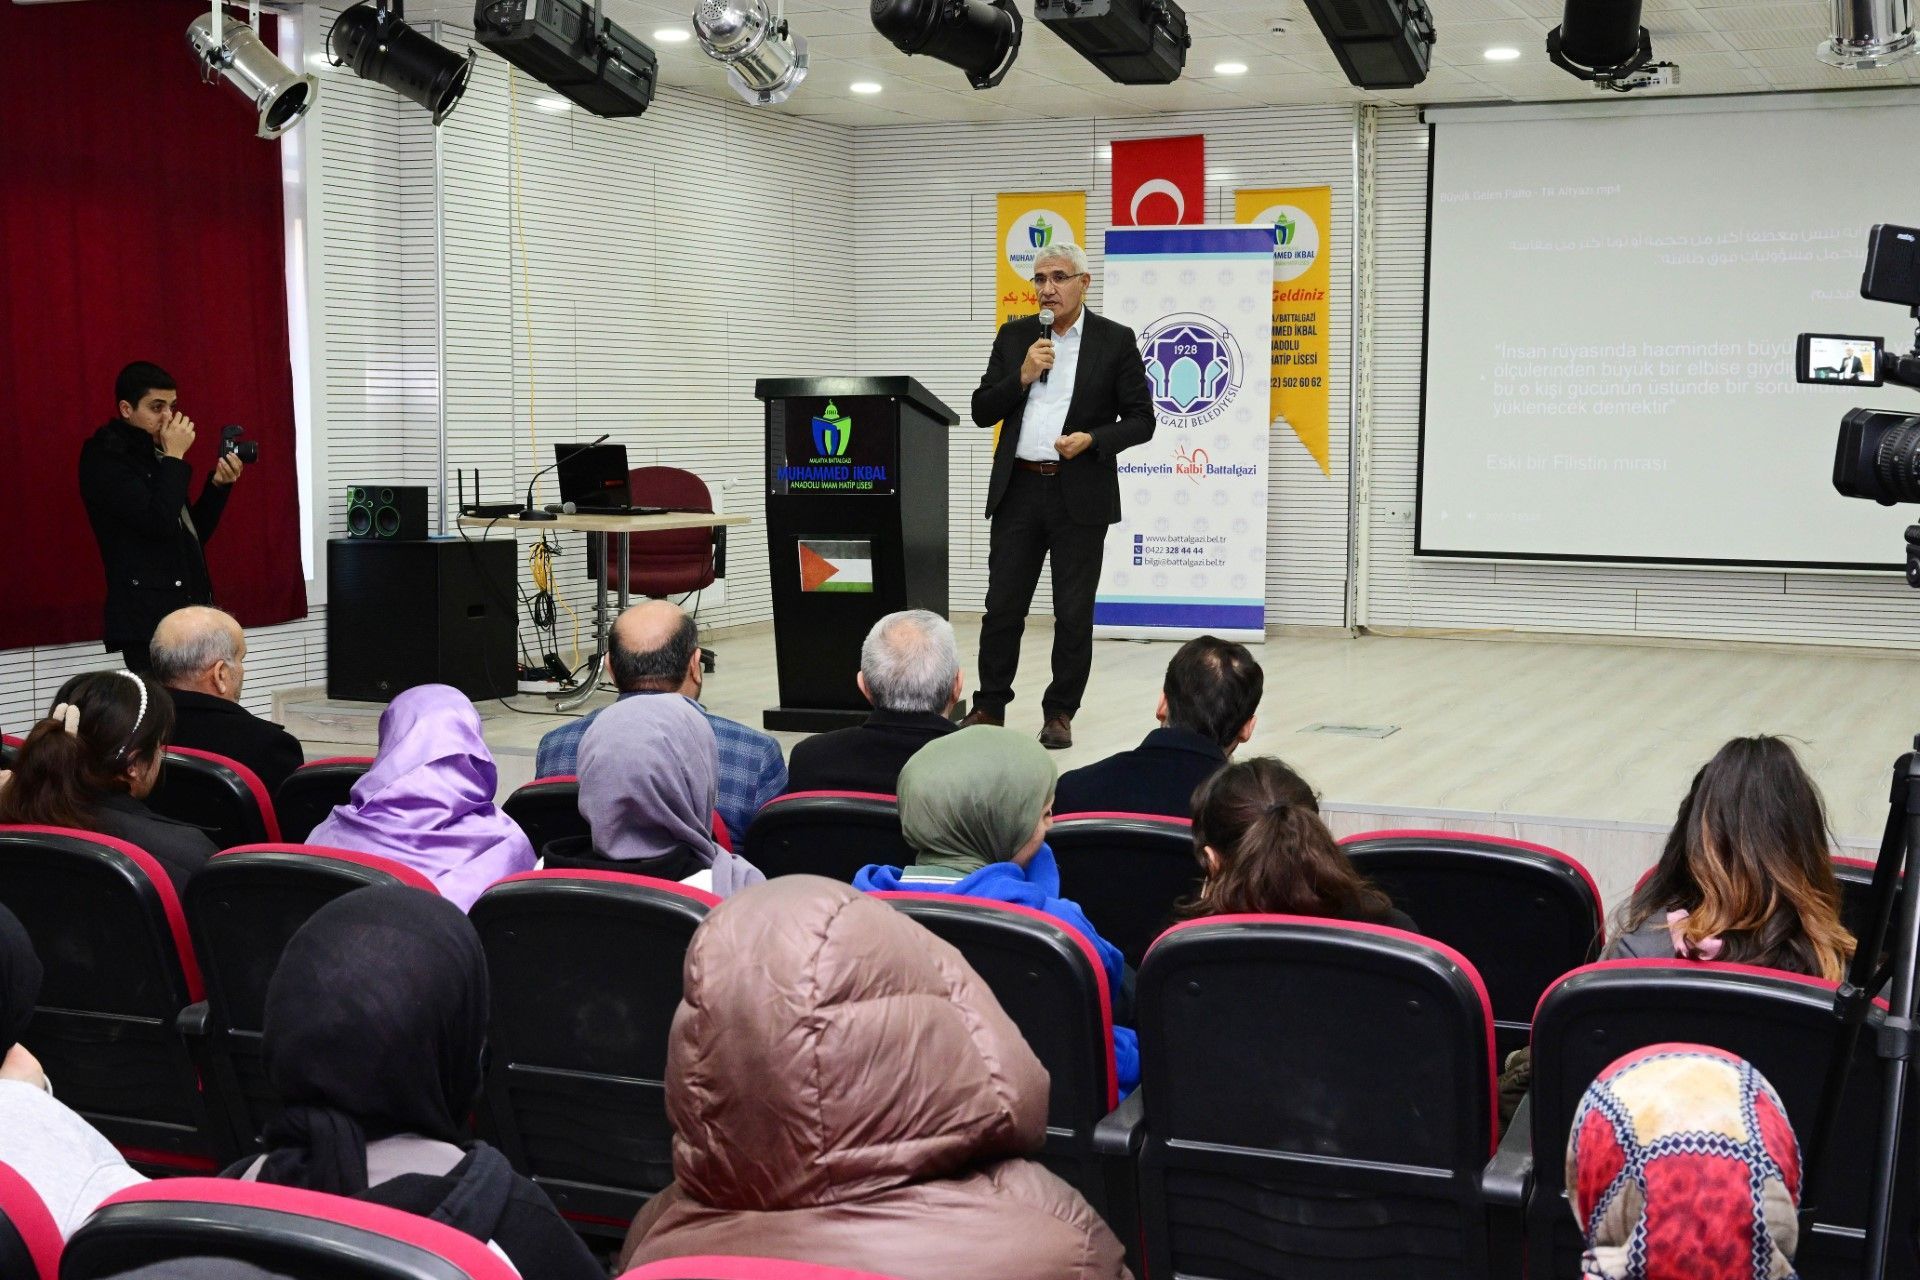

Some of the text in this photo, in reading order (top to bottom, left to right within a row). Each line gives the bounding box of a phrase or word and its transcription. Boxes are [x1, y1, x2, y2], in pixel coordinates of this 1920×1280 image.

[1294, 323, 1318, 336] İKBAL
[1174, 344, 1199, 355] 1928
[1747, 336, 1798, 360] büyü
[1293, 352, 1318, 365] LİSESİ
[1283, 376, 1298, 388] 502
[1299, 376, 1310, 388] 60
[1311, 376, 1322, 388] 62
[1494, 380, 1515, 396] bu
[1487, 453, 1522, 471] Eski
[1526, 453, 1549, 470] bir
[777, 465, 850, 481] MUHAMMED
[1176, 463, 1203, 474] Kalbi
[1206, 464, 1257, 477] Battalgazi
[790, 479, 874, 490] ANADOLU İMAM HATİP LİSESİ
[1145, 534, 1228, 544] www.battalgazi.bel.tr
[1145, 546, 1164, 554] 0422
[1165, 546, 1180, 554] 328
